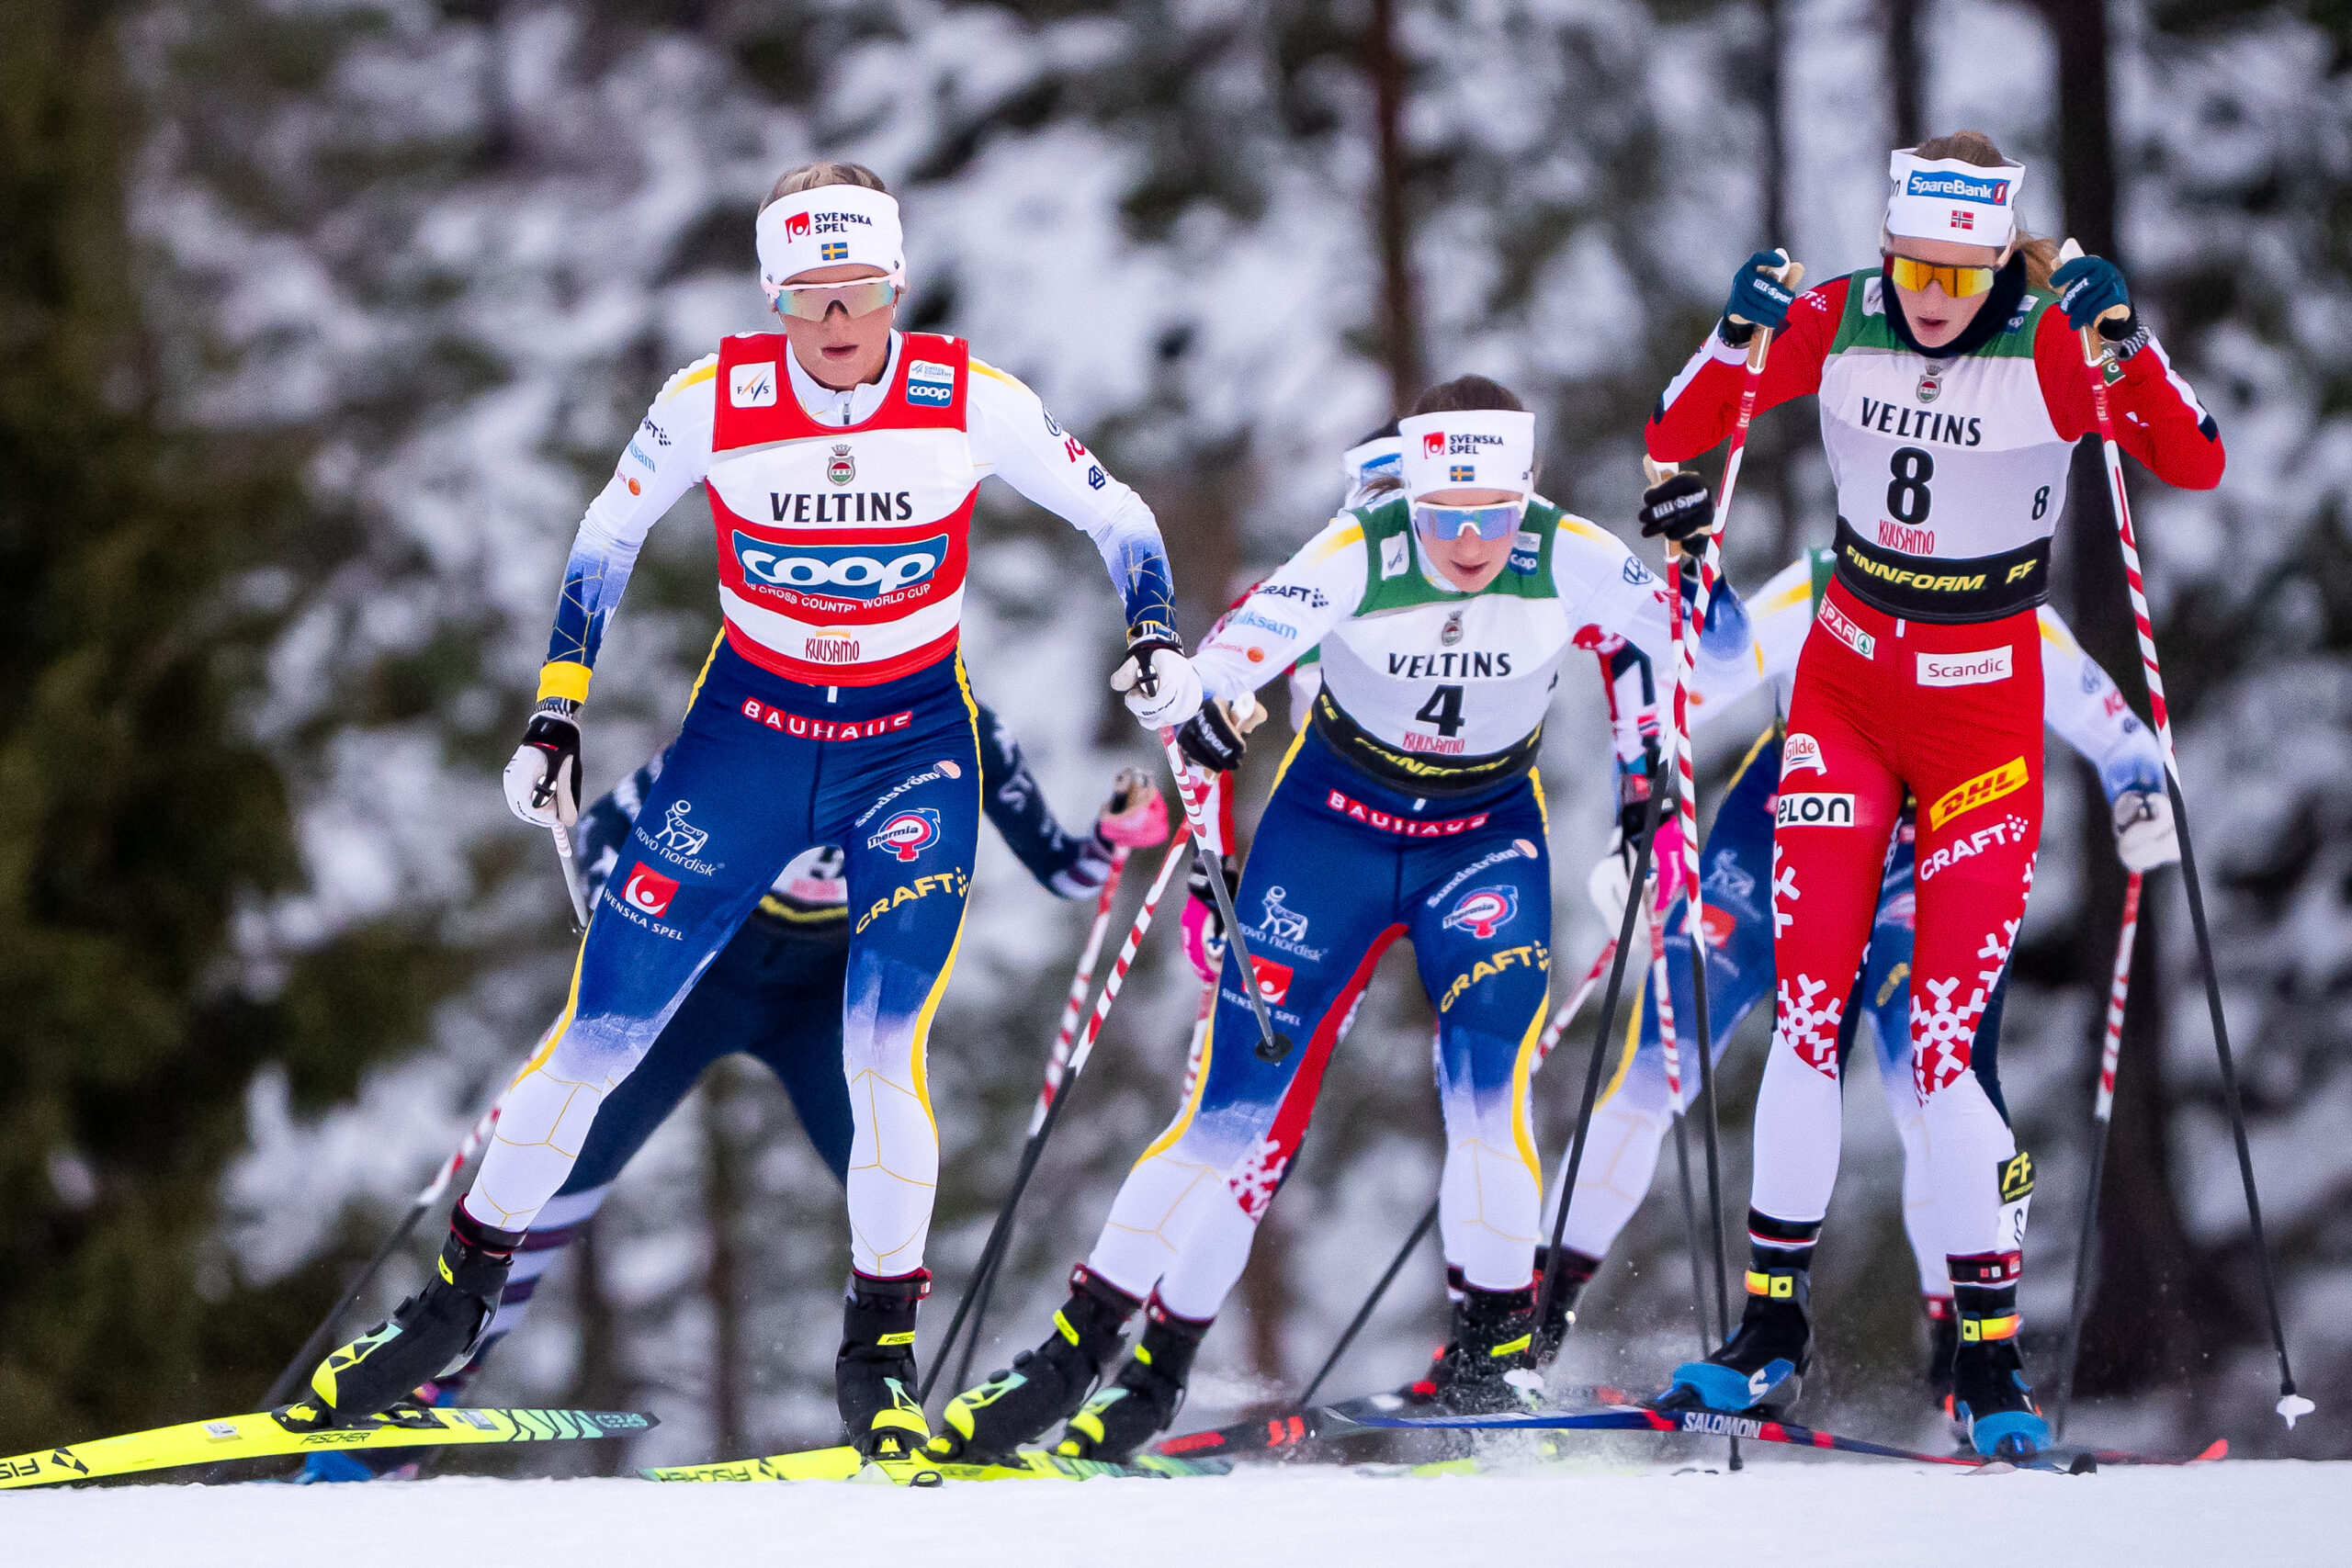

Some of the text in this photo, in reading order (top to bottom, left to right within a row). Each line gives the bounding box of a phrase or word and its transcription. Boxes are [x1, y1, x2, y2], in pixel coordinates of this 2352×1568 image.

[1910, 176, 1993, 199] SpareBank
[814, 212, 872, 226] SVENSKA
[815, 223, 848, 234] SPEL
[909, 386, 951, 400] coop
[1861, 397, 1982, 446] VELTINS
[1449, 434, 1504, 446] SVENSKA
[1449, 445, 1479, 455] SPEL
[1887, 446, 1935, 525] 8
[770, 491, 912, 523] VELTINS
[2031, 485, 2051, 521] 8
[1877, 519, 1935, 555] KUUSAMO
[741, 549, 936, 594] coop
[1847, 544, 1986, 592] FINNFORM
[759, 585, 797, 604] CROSS
[862, 591, 905, 610] WORLD
[907, 583, 932, 599] CUP
[1819, 599, 1854, 645] SPAR
[805, 637, 860, 662] KUUSAMO
[1388, 651, 1512, 678] VELTINS
[1928, 658, 2005, 678] Scandic
[1415, 684, 1465, 738] 4
[1785, 738, 1815, 761] Gilde
[1941, 772, 2016, 818] DHL
[636, 827, 717, 876] novo nordisk
[868, 825, 919, 847] Thermia
[1920, 823, 2007, 881] CRAFT
[604, 888, 684, 942] SVENSKA SPEL
[856, 873, 954, 934] CRAFT
[1441, 946, 1532, 1013] CRAFT
[300, 1432, 370, 1447] FISCHER
[1682, 1411, 1762, 1439] SALOMON
